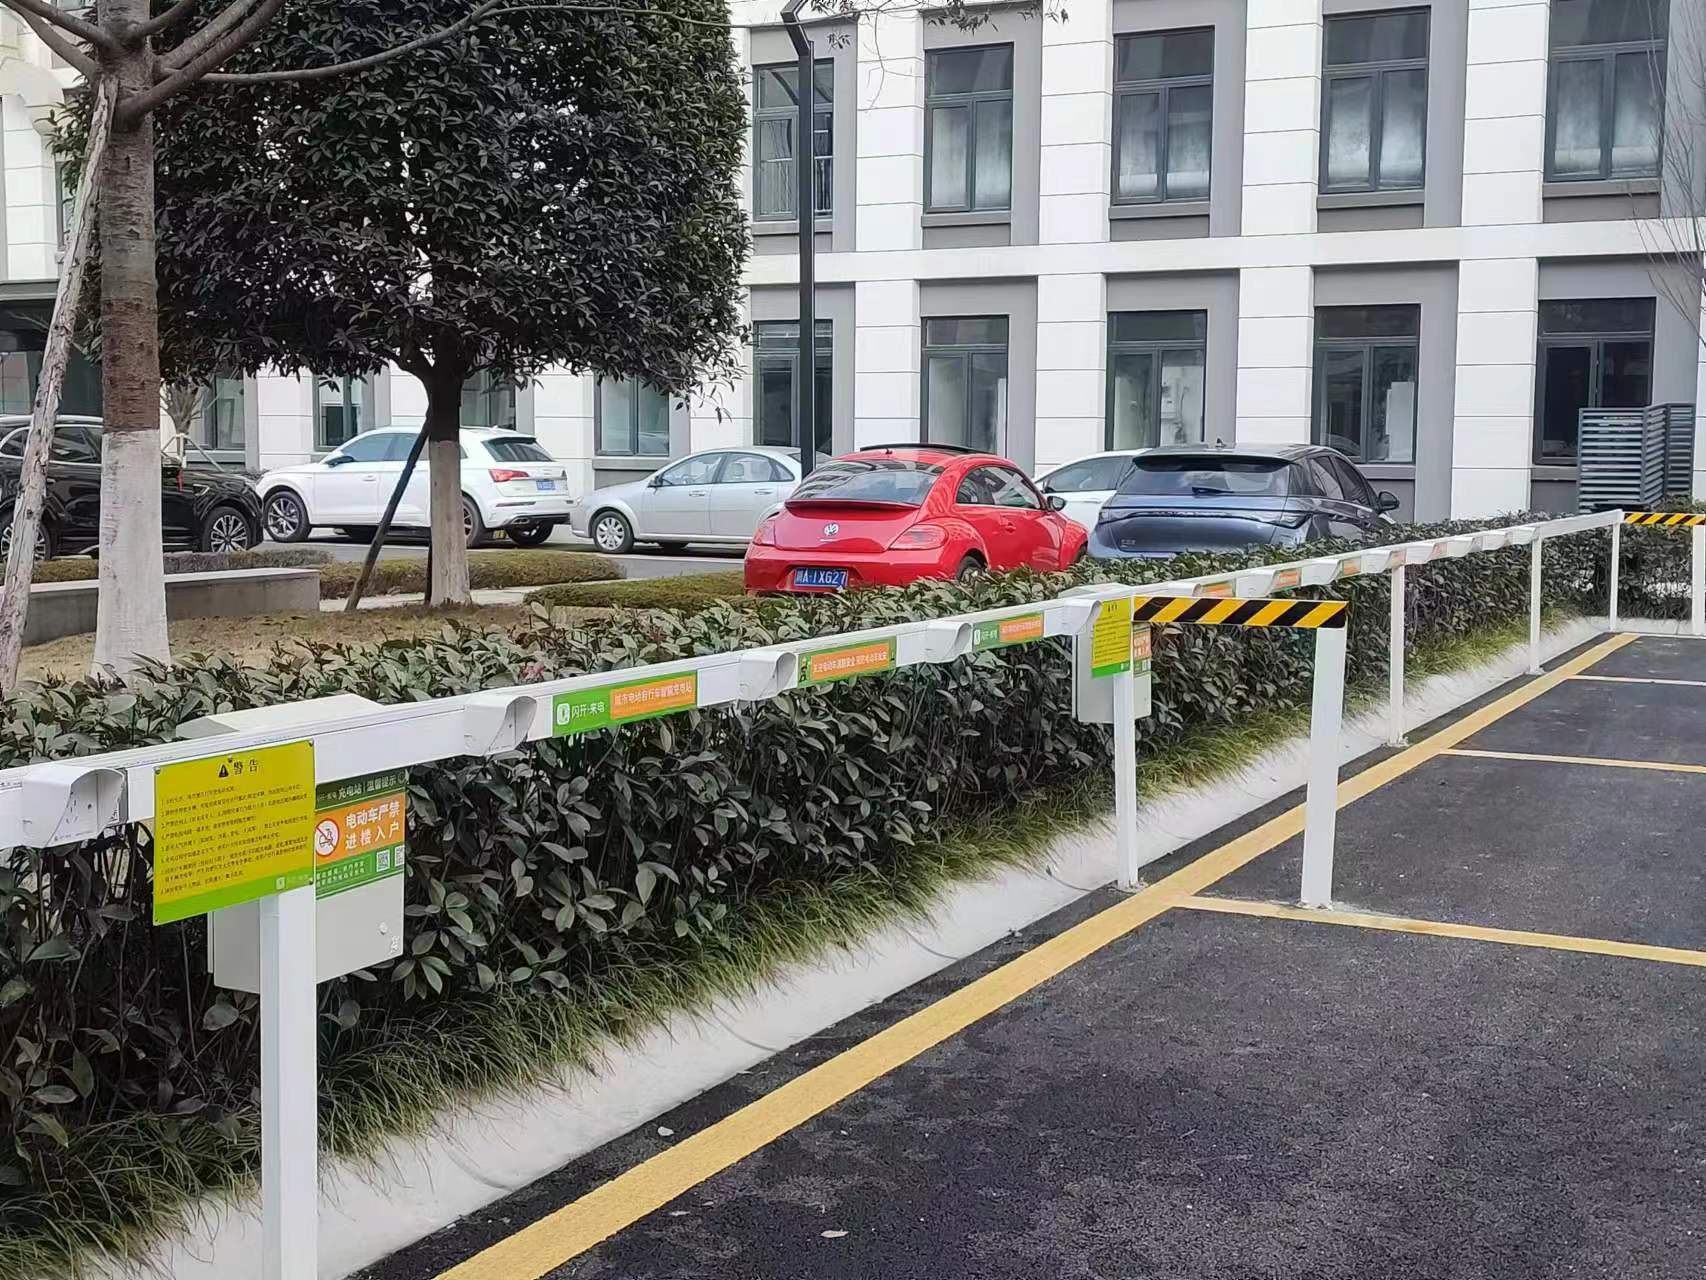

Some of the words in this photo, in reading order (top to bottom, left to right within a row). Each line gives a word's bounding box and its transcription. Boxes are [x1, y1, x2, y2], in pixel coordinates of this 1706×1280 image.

[233, 758, 258, 775] 警告
[346, 801, 400, 829] 电动车严禁
[345, 821, 400, 850] 进楼入户
